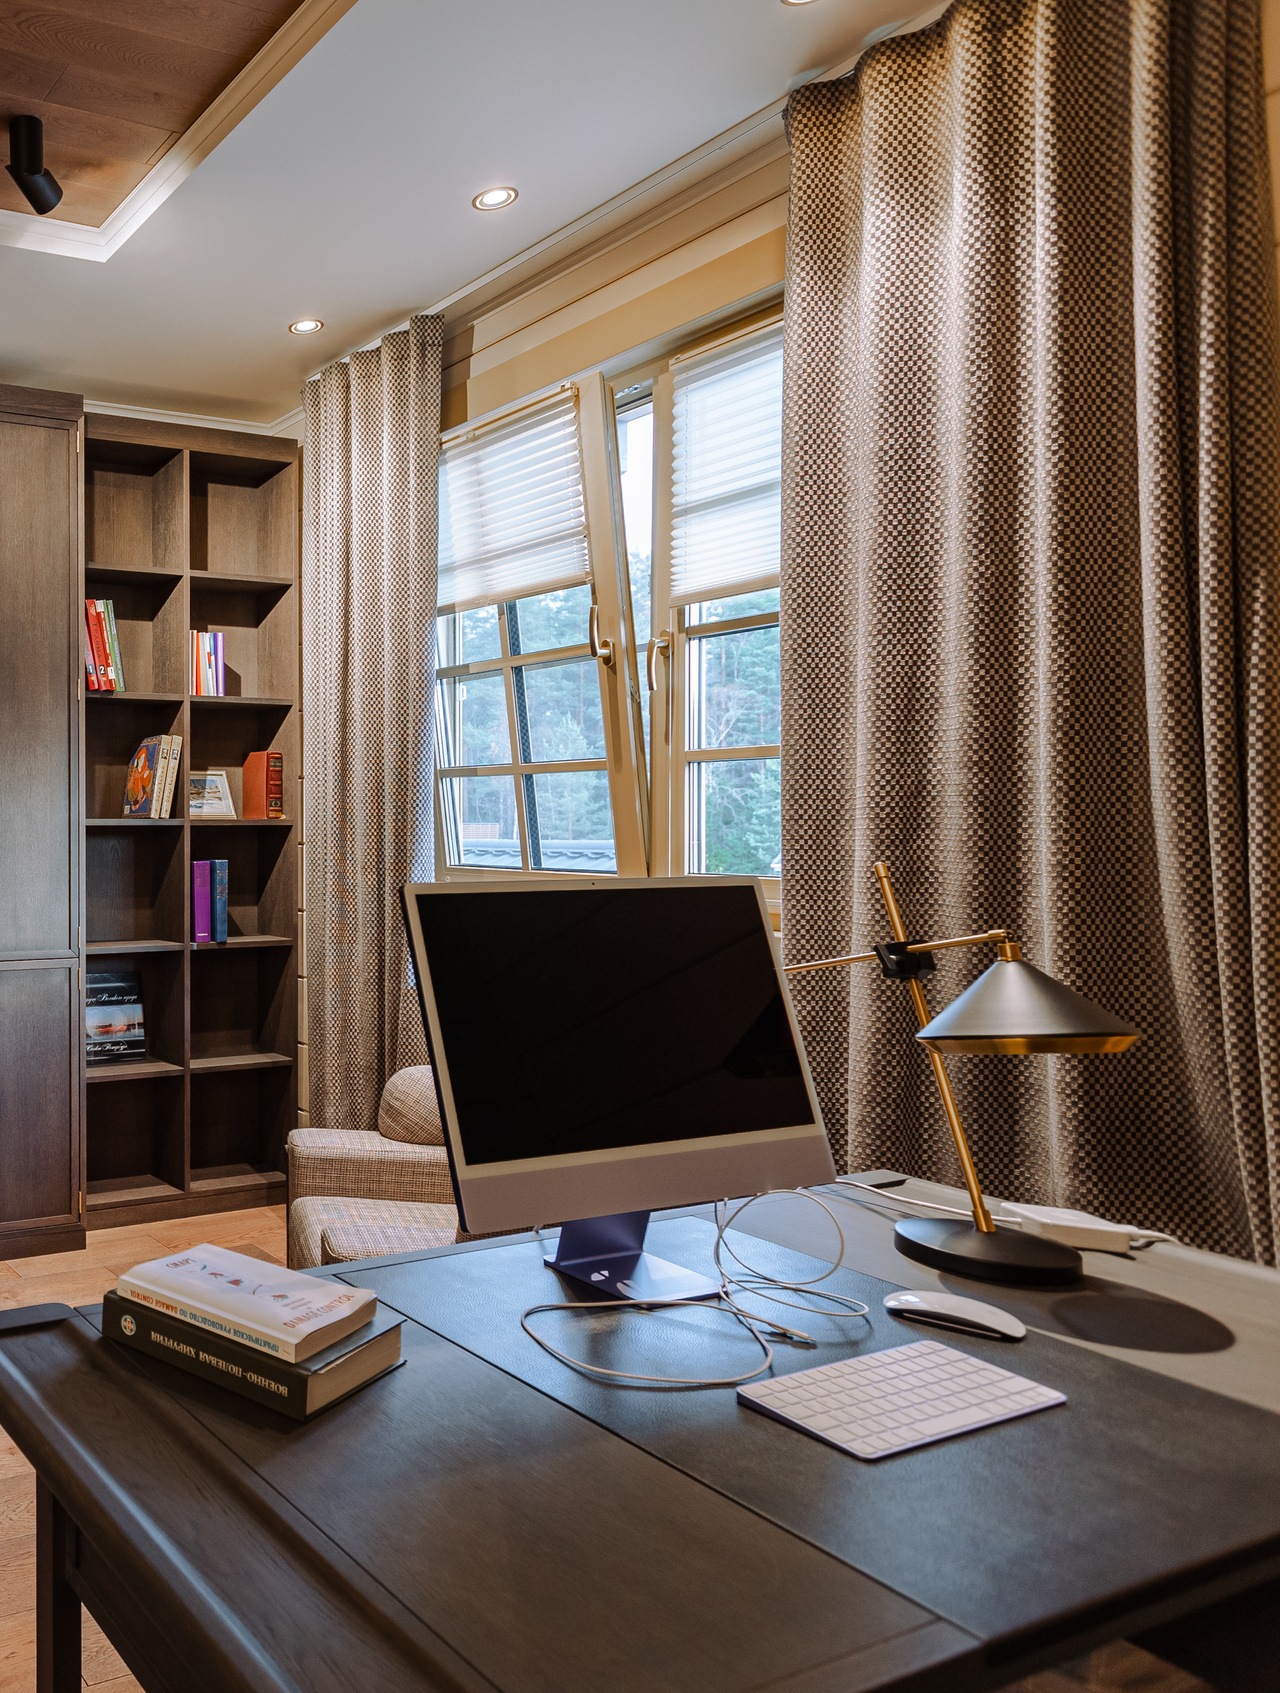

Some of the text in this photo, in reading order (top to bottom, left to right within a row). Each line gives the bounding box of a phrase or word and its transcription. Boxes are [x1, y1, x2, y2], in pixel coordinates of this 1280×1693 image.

[100, 665, 106, 674] 2
[130, 1290, 280, 1352] ПРАКТИЧЕСКОЕ РУКОВОДСТВО ПО DAMAGE CONTROL
[282, 1310, 324, 1328] DAMAGE
[316, 1294, 356, 1314] CONTROL
[151, 1331, 288, 1397] ВОЕННО-ПОЛЕВАЯ ХИРУРГИЯ
